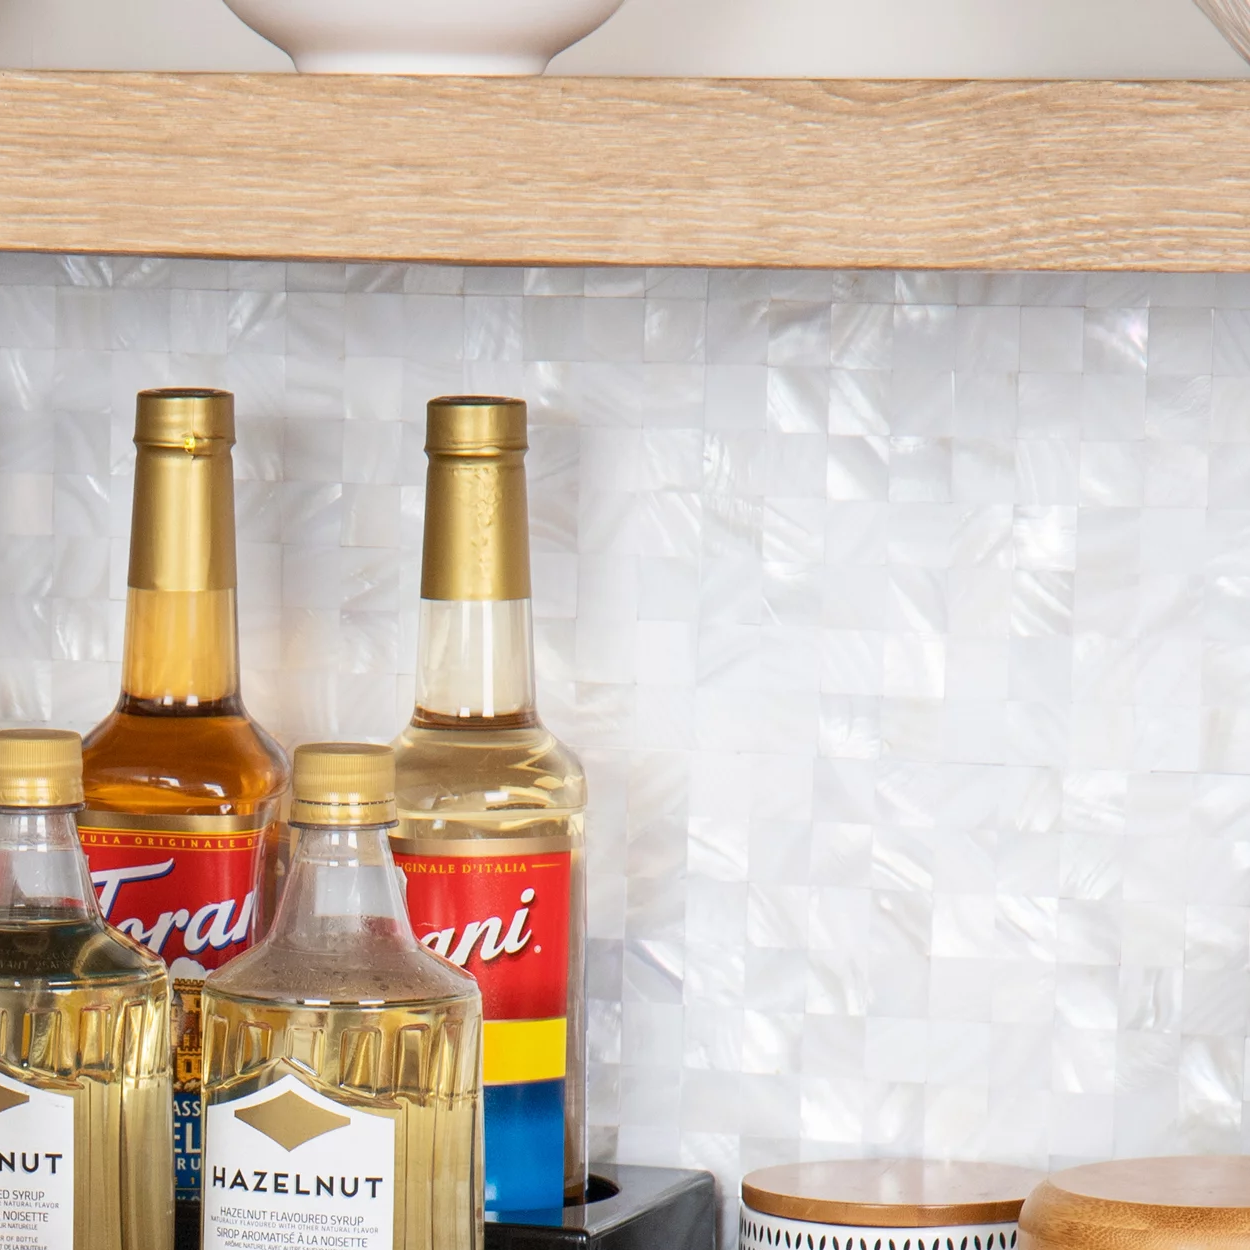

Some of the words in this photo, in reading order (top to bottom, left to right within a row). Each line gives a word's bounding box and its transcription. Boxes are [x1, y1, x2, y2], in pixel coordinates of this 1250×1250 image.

[80, 833, 120, 844] MULA
[135, 836, 235, 848] ORIGINALE
[462, 863, 527, 873] D'ITALIA
[212, 1165, 383, 1199] HAZELNUT
[12, 1190, 45, 1201] SYRUP
[3, 1200, 32, 1208] NATURAL
[2, 1210, 49, 1223] NOISETTE
[219, 1206, 268, 1220] HAZELNUT
[270, 1211, 328, 1224] FLAVOURED
[330, 1215, 365, 1226] SYRUP
[210, 1215, 237, 1224] NATURALLY
[240, 1219, 277, 1229] FLAVOURED
[321, 1225, 351, 1233] NATURAL
[216, 1226, 240, 1239] SIROP
[241, 1230, 295, 1244] AROMATISÉ
[297, 1232, 305, 1245] À
[306, 1235, 318, 1245] LA
[320, 1236, 369, 1248] NOISETTE
[243, 1242, 267, 1250] NATUREL
